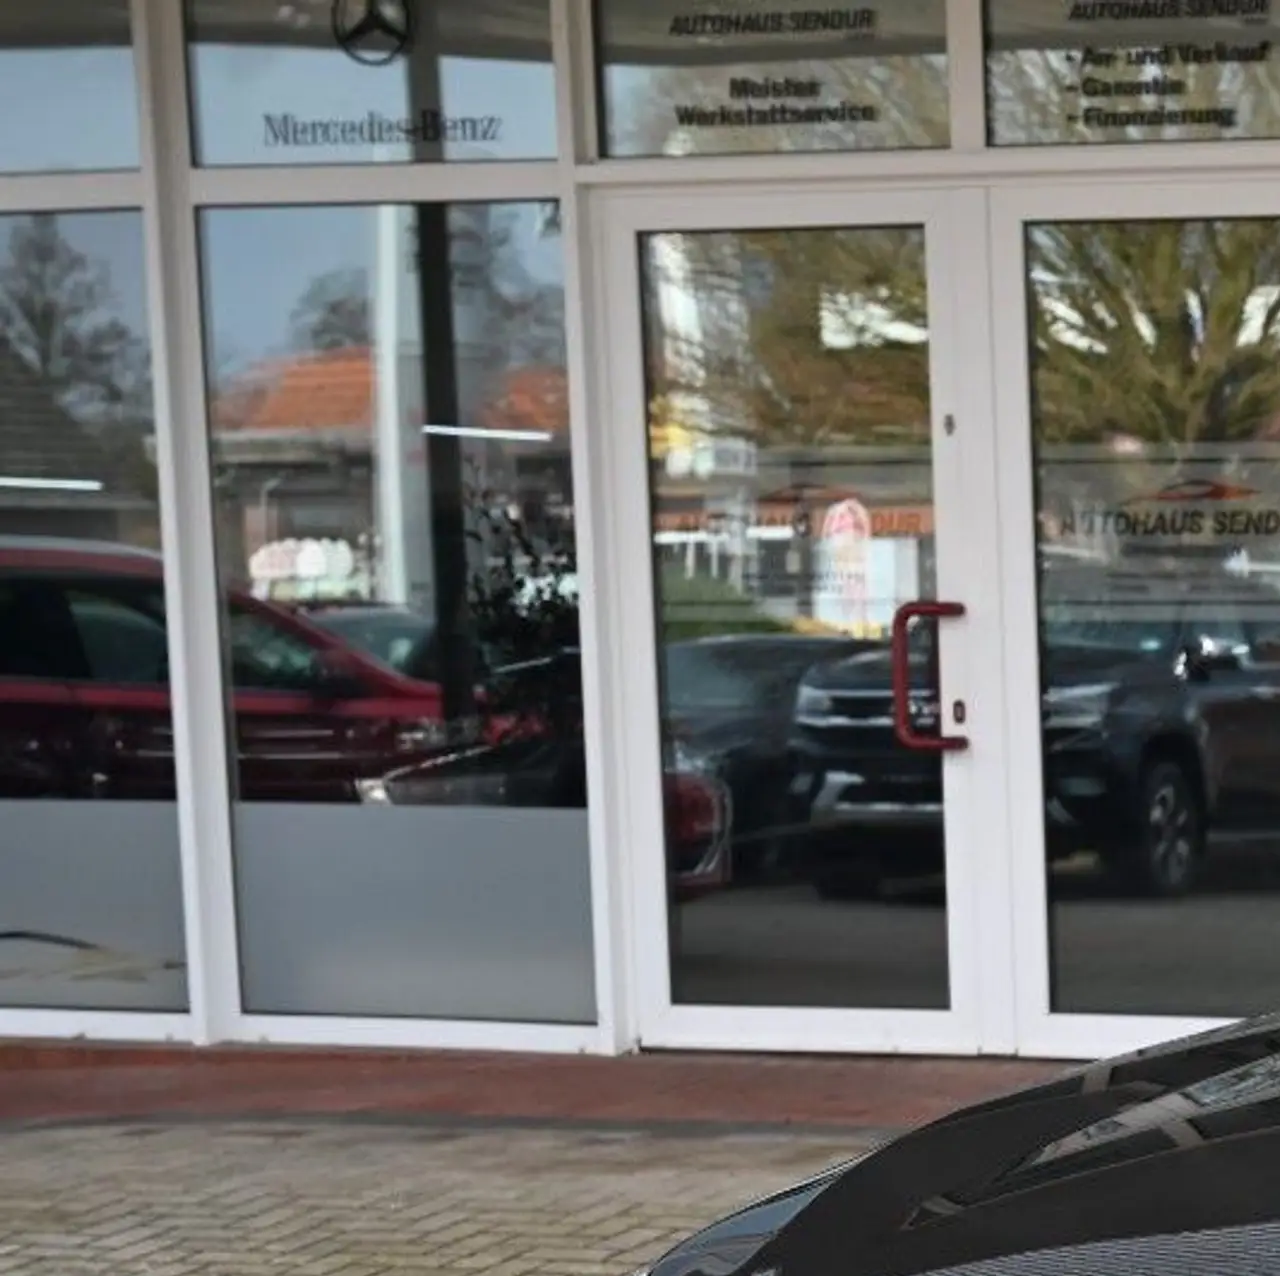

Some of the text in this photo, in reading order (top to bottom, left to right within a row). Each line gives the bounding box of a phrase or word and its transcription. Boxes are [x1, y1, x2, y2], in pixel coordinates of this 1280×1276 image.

[1069, 0, 1268, 20] AUTOHAUS SENDUR
[669, 9, 877, 35] AUTOHAUS SENDUR
[1177, 41, 1270, 62] Verkauf
[730, 77, 822, 98] Meister
[1082, 76, 1187, 96] Garantie
[675, 101, 880, 125] Werkstattservice
[1083, 106, 1238, 127] Finanzierung
[263, 109, 503, 146] Mercedes-Benz
[1059, 511, 1207, 537] AUTOHAUS
